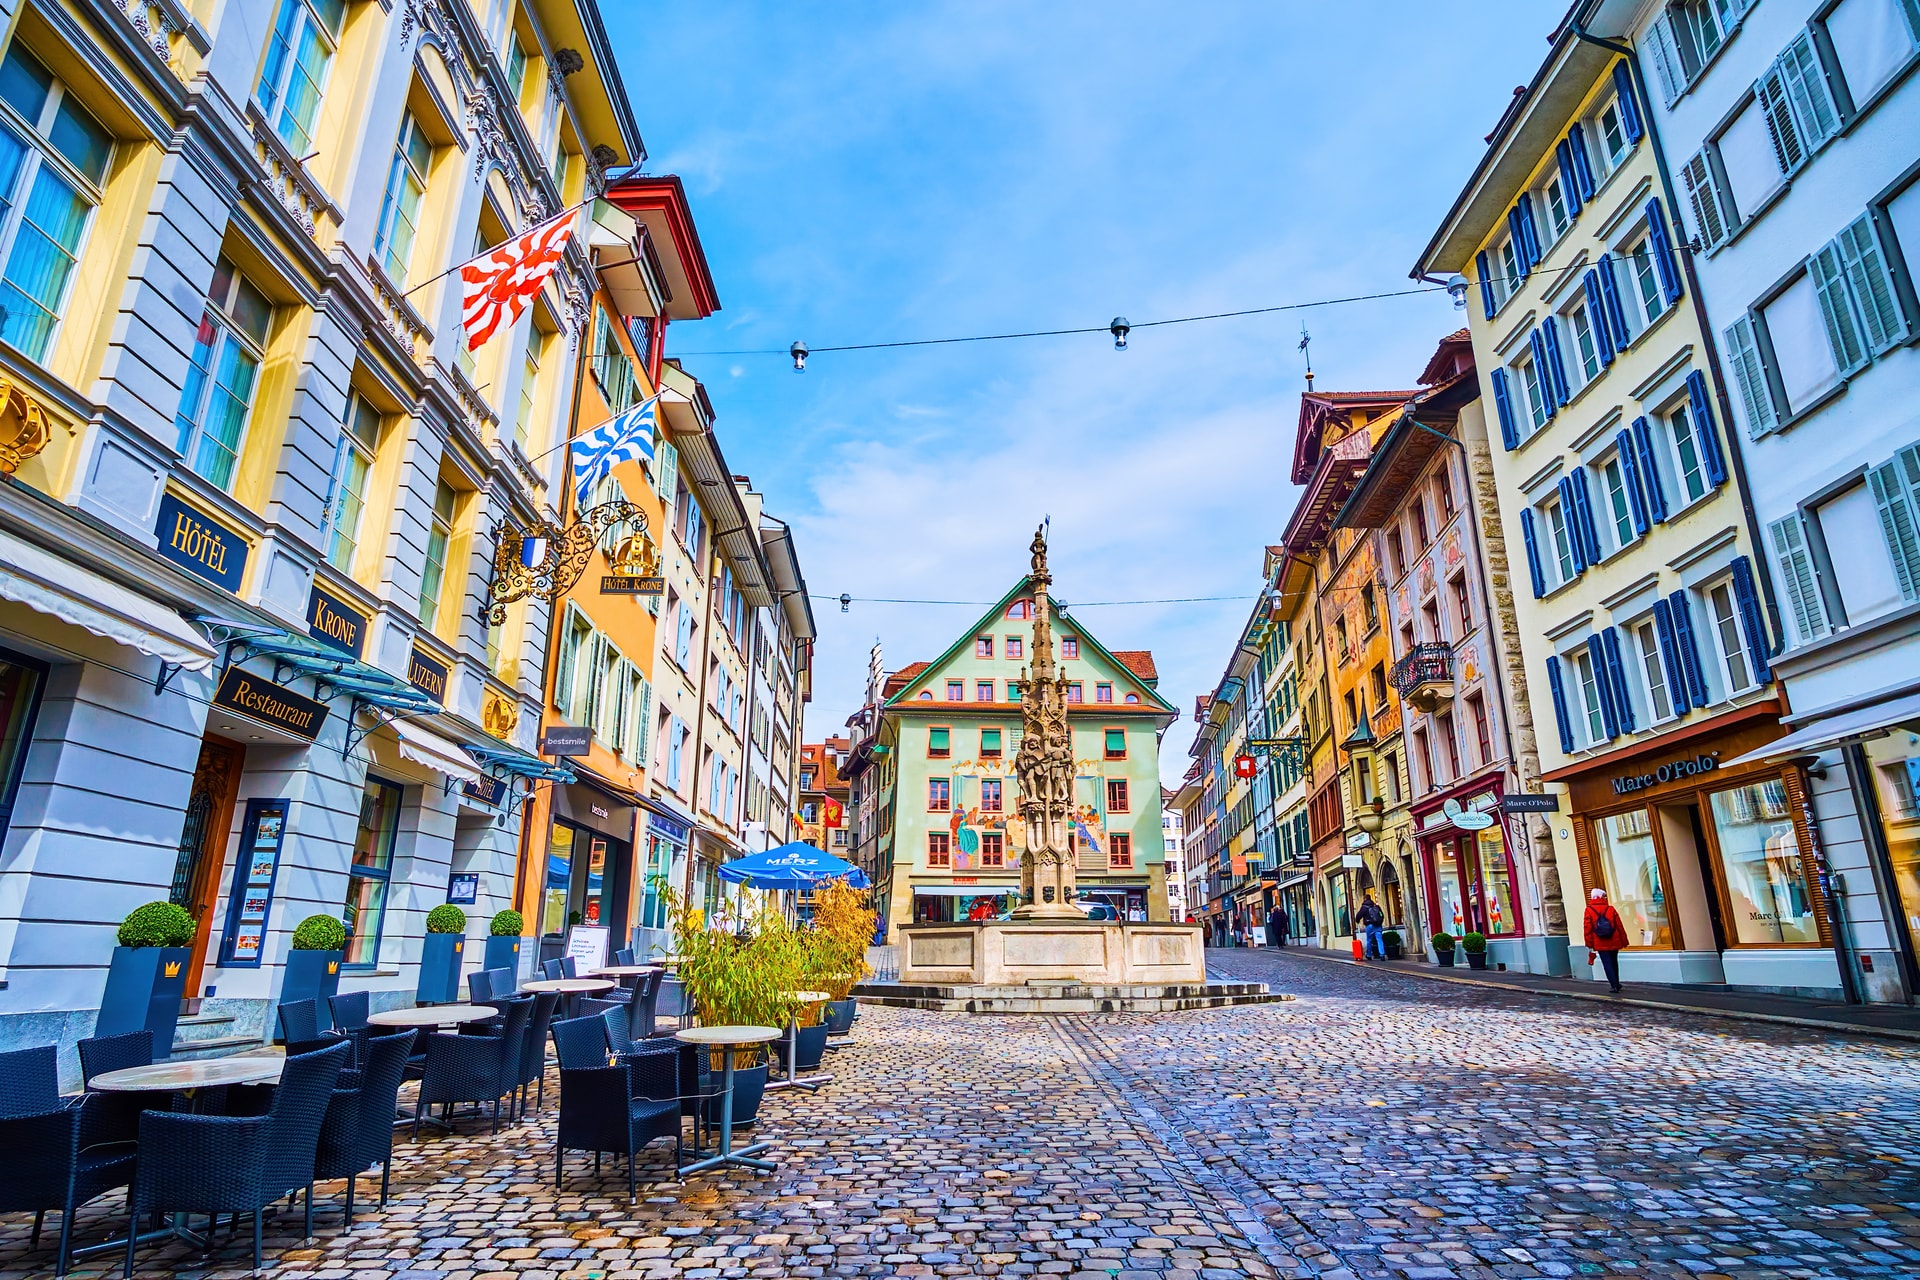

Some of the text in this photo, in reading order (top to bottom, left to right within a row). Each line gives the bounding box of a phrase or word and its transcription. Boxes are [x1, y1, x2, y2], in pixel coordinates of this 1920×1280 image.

[633, 578, 663, 591] KRONE
[313, 597, 357, 647] KRONE
[408, 655, 444, 697] LUZERN
[231, 679, 314, 729] Restaurant
[547, 737, 586, 745] bestsmile
[1611, 754, 1714, 795] Marc O'Polo
[1528, 799, 1554, 807] O'Polo
[766, 858, 819, 866] MERZ
[1749, 912, 1772, 920] Marc
